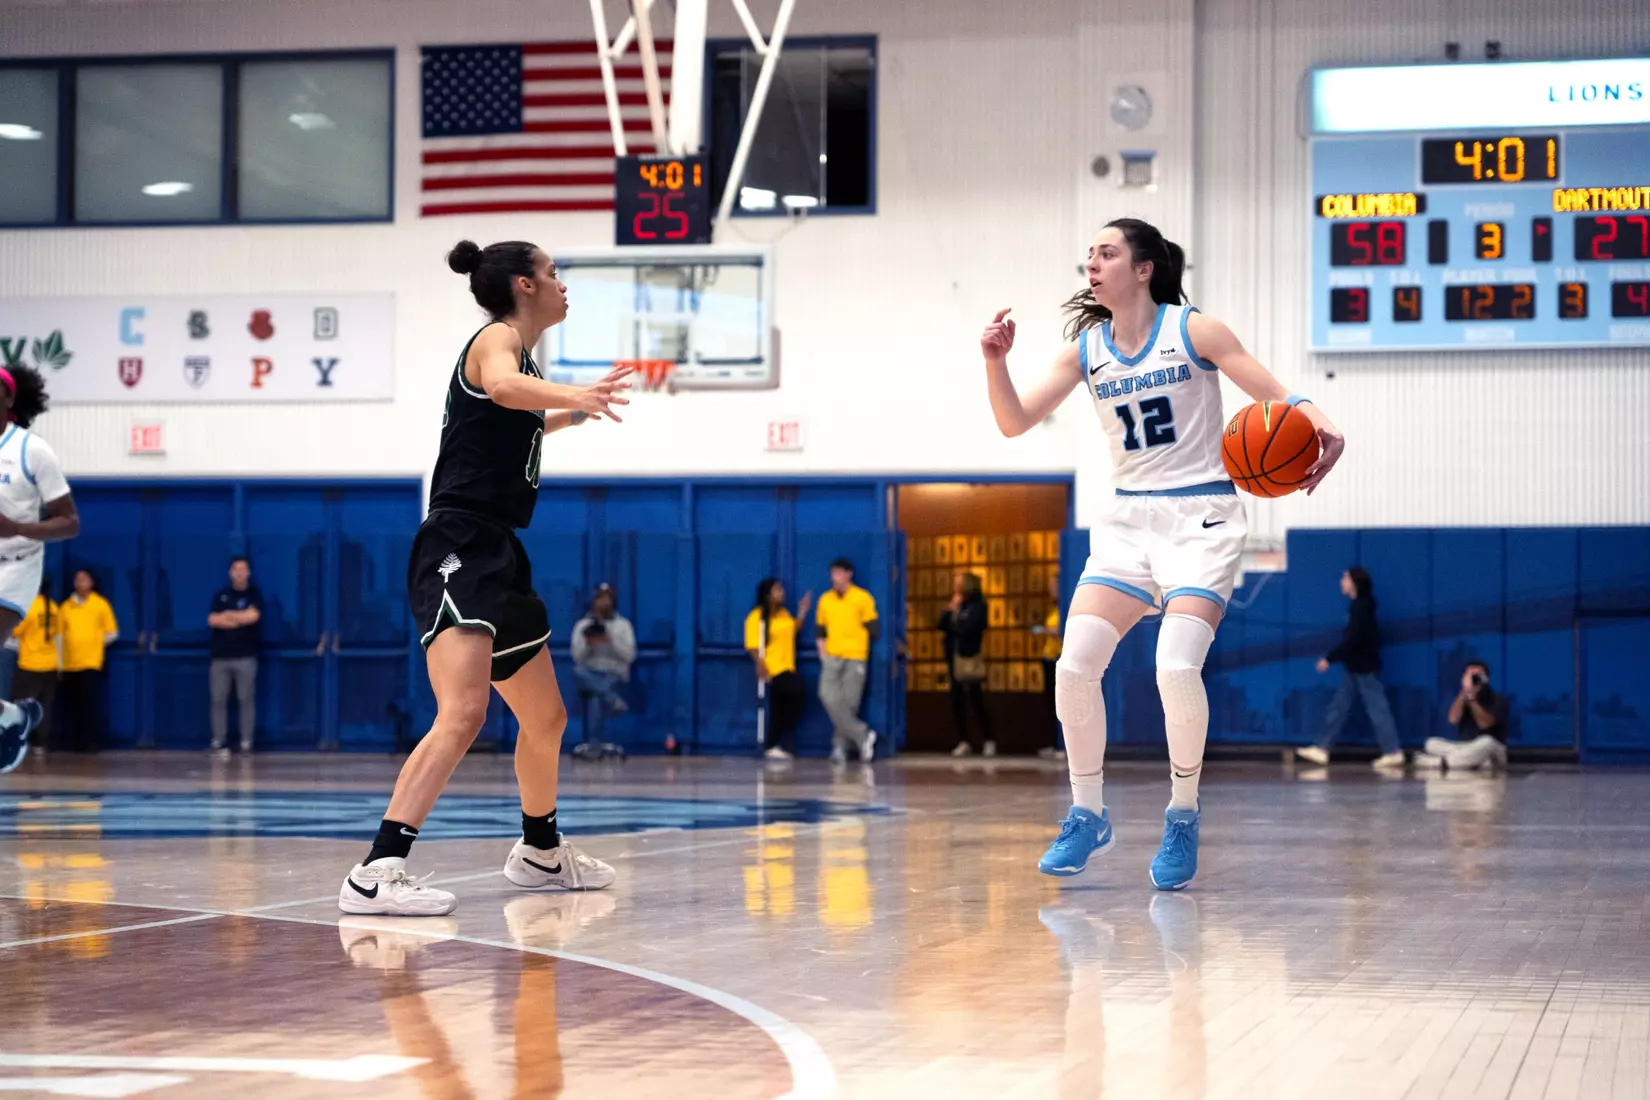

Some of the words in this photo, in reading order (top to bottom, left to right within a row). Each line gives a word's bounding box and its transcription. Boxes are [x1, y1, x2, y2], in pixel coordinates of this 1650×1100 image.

[1548, 82, 1643, 103] LIONS
[639, 160, 702, 190] 4:01
[1454, 137, 1556, 182] 4:01
[633, 192, 689, 239] 25
[1321, 193, 1417, 218] COLUMBIA
[1346, 221, 1404, 265] 58
[1481, 223, 1501, 259] 3
[1591, 215, 1649, 260] 27
[1347, 288, 1366, 322] 3
[1396, 288, 1419, 319] 4
[1461, 285, 1494, 319] 12
[1511, 284, 1532, 318] 2
[1565, 283, 1584, 317] 3
[1626, 284, 1648, 315] 4
[119, 307, 144, 346] C
[250, 356, 273, 389] P
[311, 357, 340, 388] Y
[1114, 395, 1178, 452] 12
